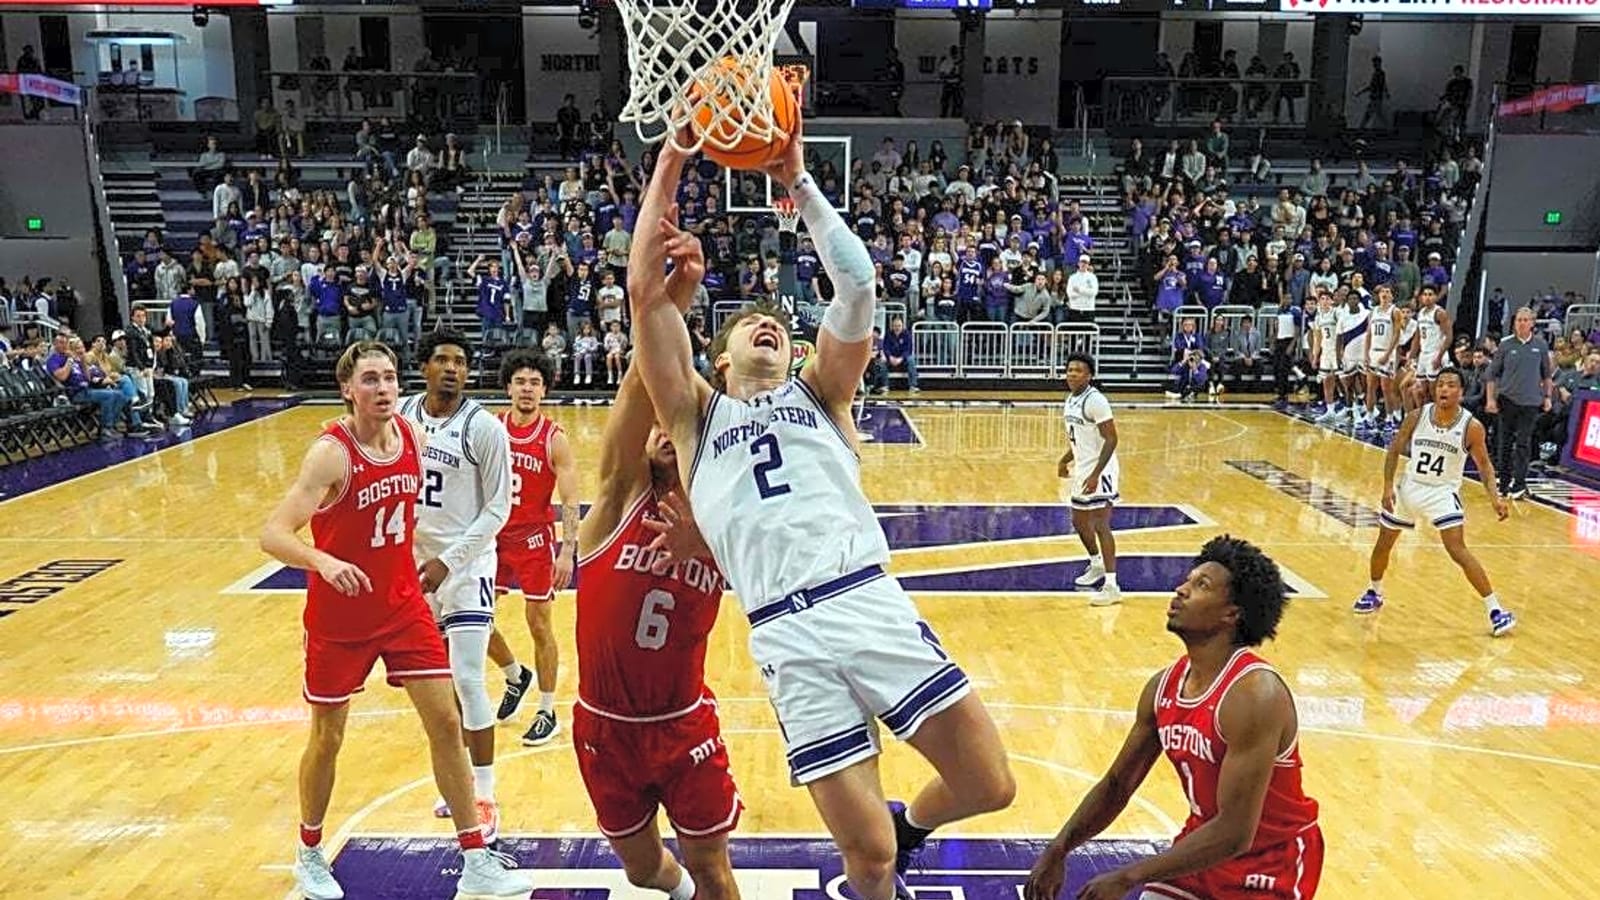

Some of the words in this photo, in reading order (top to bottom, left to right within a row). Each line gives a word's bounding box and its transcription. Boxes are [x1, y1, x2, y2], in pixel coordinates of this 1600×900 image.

[750, 433, 792, 500] 2
[1416, 451, 1446, 477] 24
[357, 474, 419, 511] BOSTON
[414, 469, 443, 509] 2
[1101, 474, 1113, 494] N
[370, 500, 407, 548] 14
[479, 576, 494, 609] N
[791, 592, 808, 611] N
[635, 588, 676, 651] 6
[1181, 761, 1203, 817] 1
